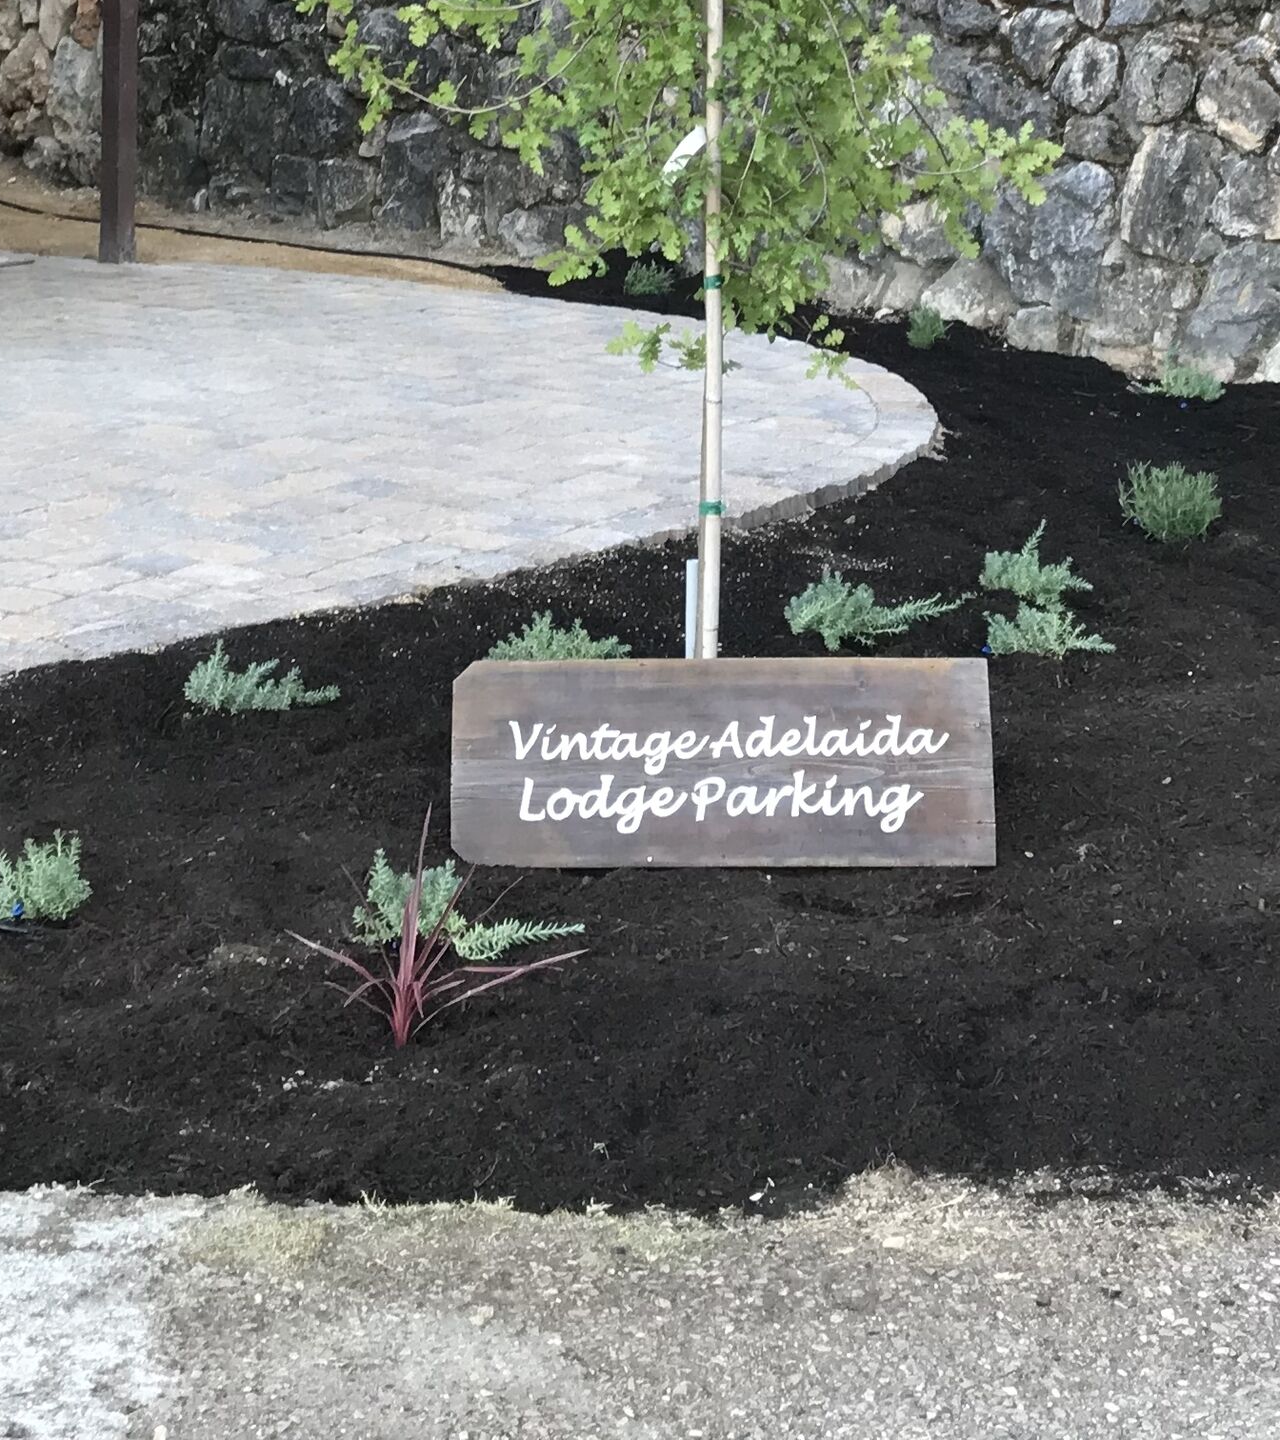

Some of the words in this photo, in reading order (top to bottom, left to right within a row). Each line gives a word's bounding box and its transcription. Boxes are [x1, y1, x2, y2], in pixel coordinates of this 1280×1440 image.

[508, 719, 711, 775] Vintage
[710, 714, 950, 760] Adelaida
[518, 774, 691, 835] Lodge
[691, 769, 925, 834] Parking
